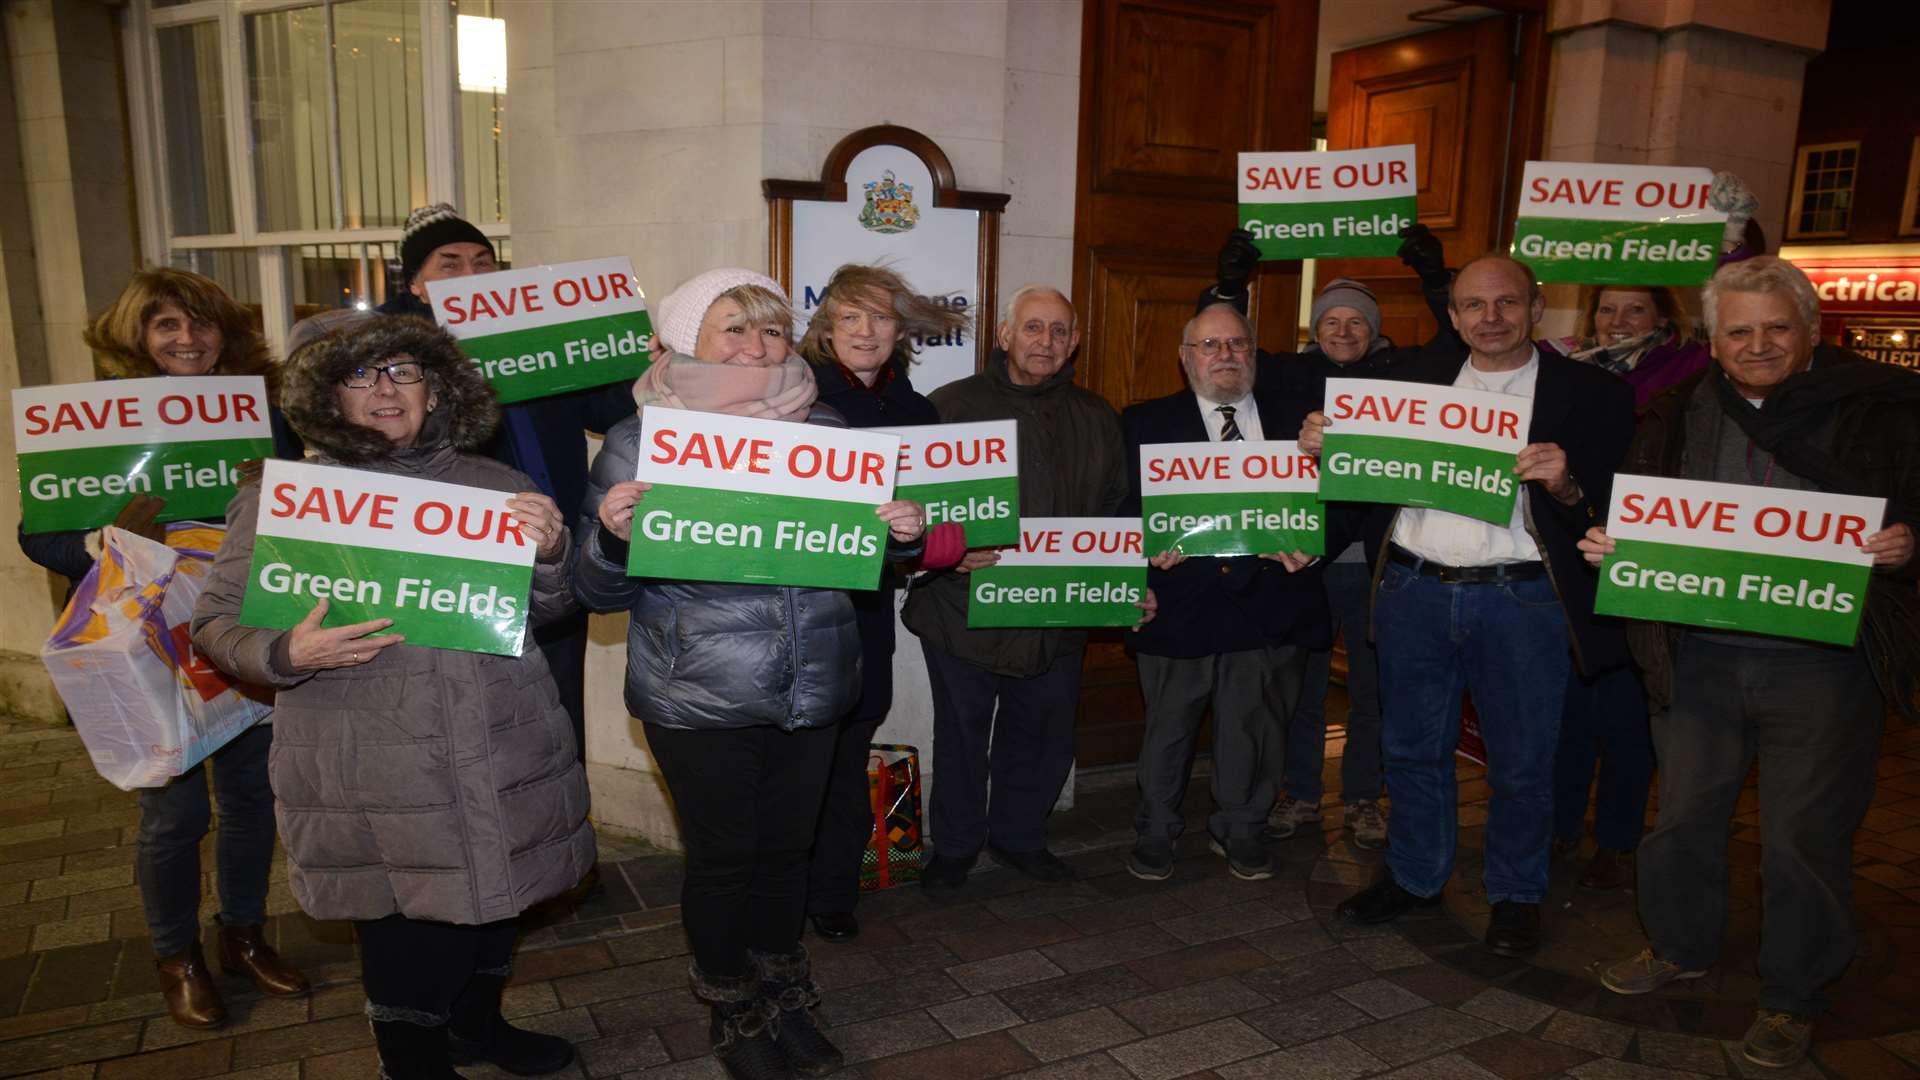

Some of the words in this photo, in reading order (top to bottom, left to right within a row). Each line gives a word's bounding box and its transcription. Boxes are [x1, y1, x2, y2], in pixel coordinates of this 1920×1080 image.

[1245, 166, 1321, 191] SAVE
[1333, 160, 1407, 189] OUR
[1530, 177, 1623, 206] SAVE
[1245, 220, 1324, 239] Green
[1520, 235, 1612, 259] Green
[1621, 239, 1712, 261] Fields
[443, 284, 544, 324] SAVE
[553, 272, 633, 307] OUR
[1811, 273, 1920, 301] ctrica
[564, 331, 650, 364] Fields
[25, 397, 143, 436] SAVE
[158, 393, 259, 425] OUR
[1333, 394, 1428, 425] SAVE
[1439, 403, 1519, 439] OUR
[650, 429, 774, 473] SAVE
[788, 445, 885, 487] OUR
[925, 438, 1007, 468] OUR
[1148, 455, 1230, 482] SAVE
[1243, 455, 1318, 479] OUR
[30, 470, 152, 500] Green
[164, 460, 239, 490] Fiel
[1329, 453, 1421, 480] Green
[1432, 461, 1512, 496] Fields
[271, 483, 399, 529] SAVE
[414, 502, 525, 547] OUR
[926, 496, 1009, 525] Fields
[1149, 511, 1232, 533] Green
[1241, 508, 1319, 530] Fields
[1619, 493, 1739, 534] SAVE
[1754, 507, 1866, 547] OUR
[643, 511, 762, 547] Green
[775, 521, 877, 556] Fields
[1013, 531, 1062, 554] VE
[1072, 531, 1142, 554] OUR
[260, 563, 381, 604] Green
[396, 578, 516, 619] Fields
[976, 583, 1056, 603] Green
[1066, 582, 1139, 603] Fields
[1610, 561, 1725, 597] Green
[1738, 575, 1855, 613] Fields
